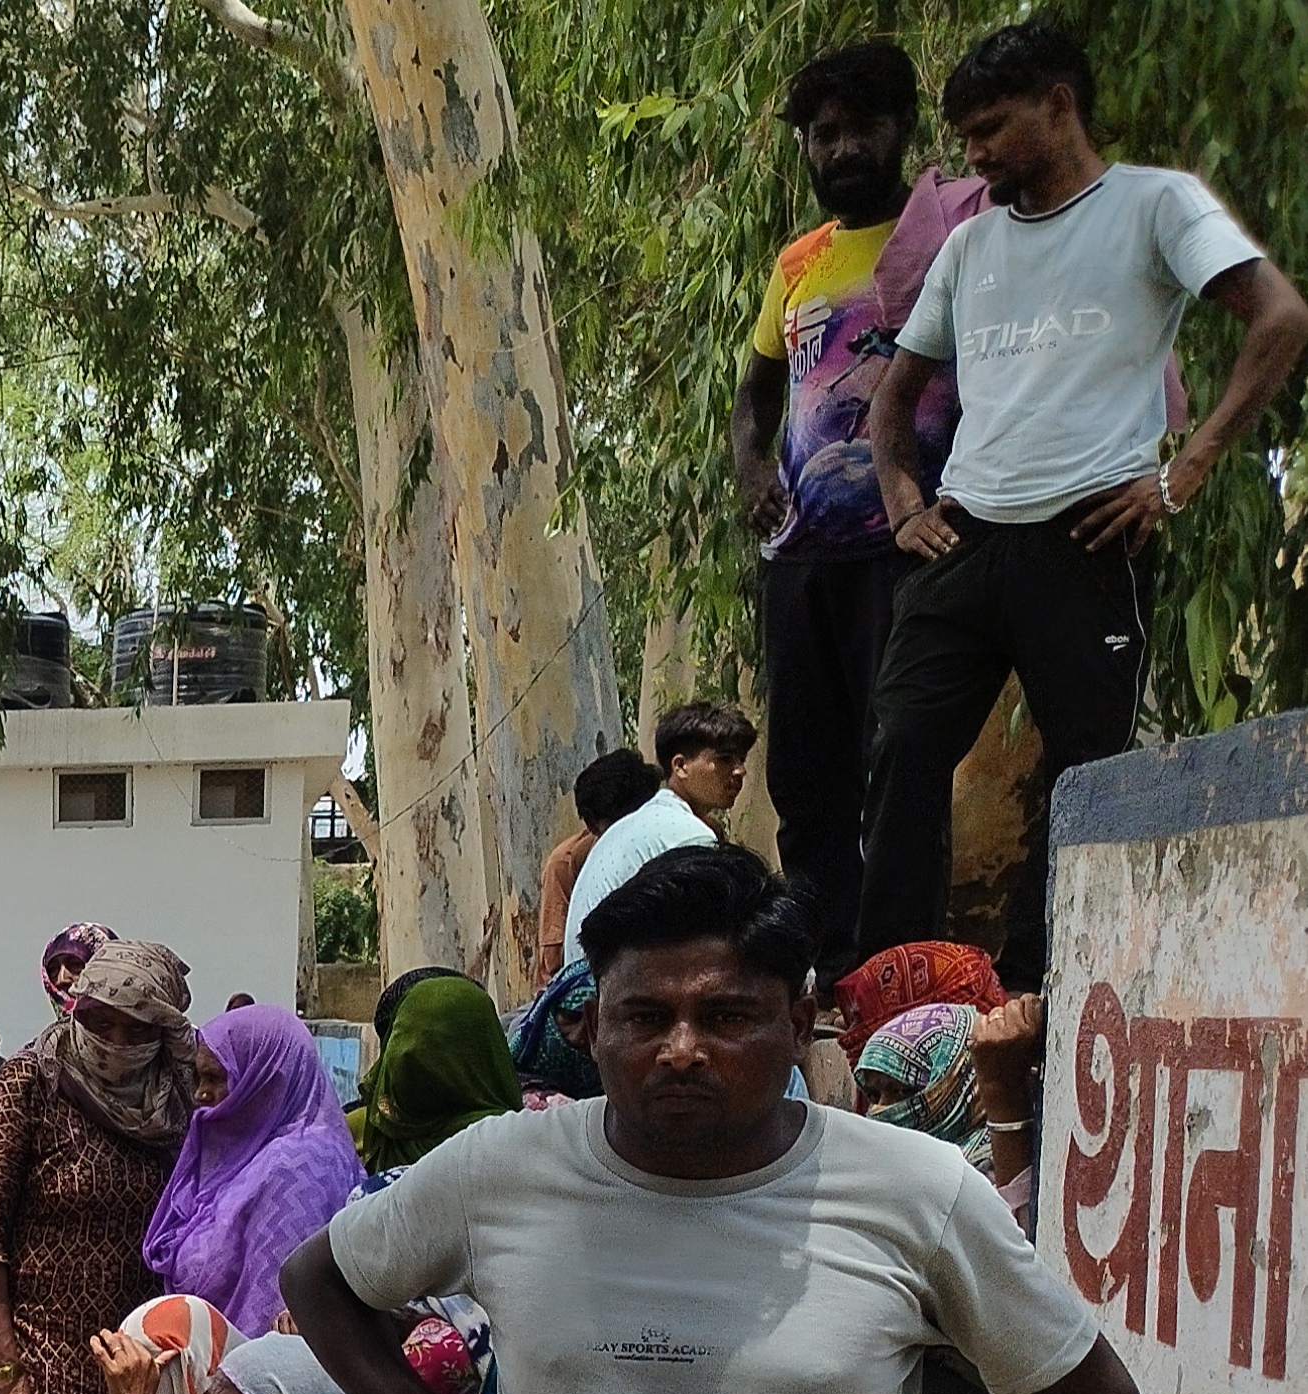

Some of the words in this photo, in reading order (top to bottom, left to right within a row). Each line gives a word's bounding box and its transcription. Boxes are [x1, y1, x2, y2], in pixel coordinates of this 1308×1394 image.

[962, 308, 1111, 358] ETIHAD
[980, 340, 1057, 362] AIRWAYS
[1064, 980, 1308, 1382] थाना
[621, 1342, 669, 1355] SPORTS
